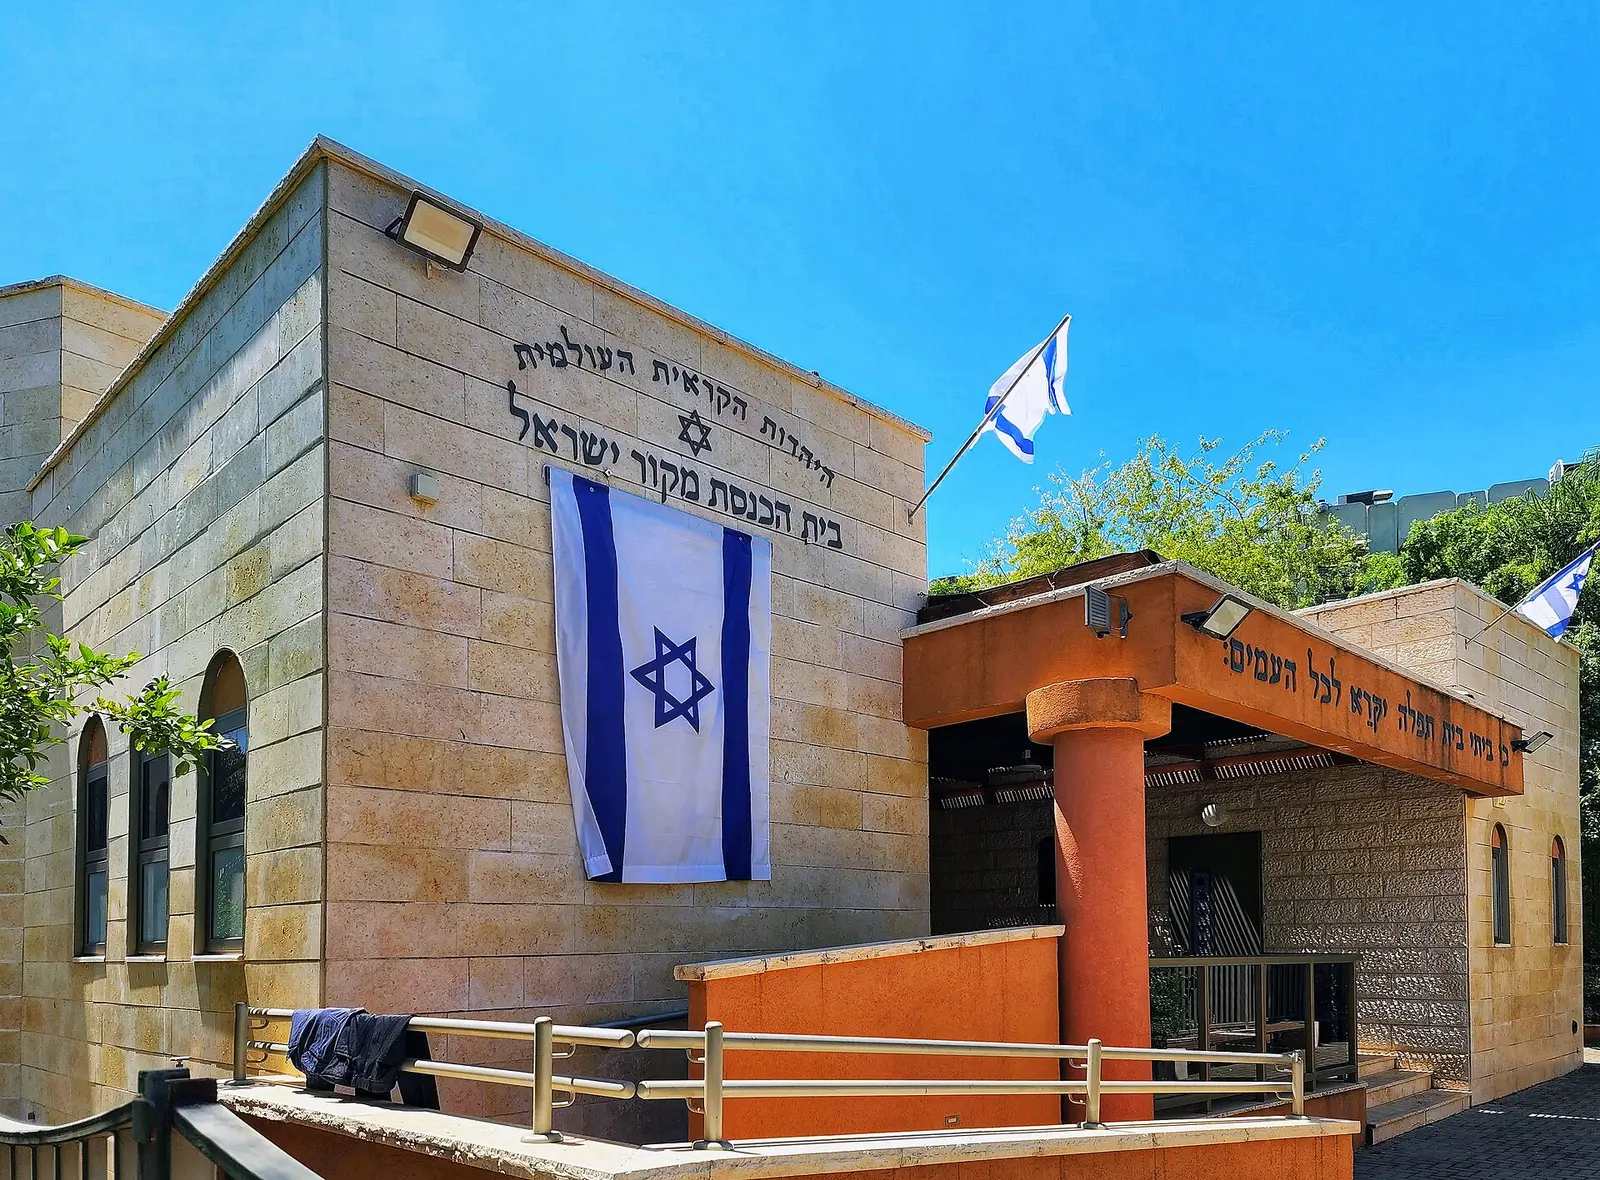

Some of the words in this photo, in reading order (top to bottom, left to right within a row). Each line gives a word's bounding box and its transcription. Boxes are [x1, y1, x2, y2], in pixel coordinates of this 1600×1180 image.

[512, 324, 636, 376] העולמית
[652, 359, 748, 421] הקראית
[506, 380, 620, 465] ישראל
[630, 448, 700, 504] מקור
[759, 415, 835, 488] היהדות
[708, 476, 791, 535] הכנסת
[801, 510, 842, 549] בית
[1223, 637, 1297, 693] העמים:
[1307, 647, 1341, 707] לכל
[1397, 689, 1435, 741] תפלה
[1442, 720, 1465, 750] בית
[1469, 731, 1494, 761] ביתי
